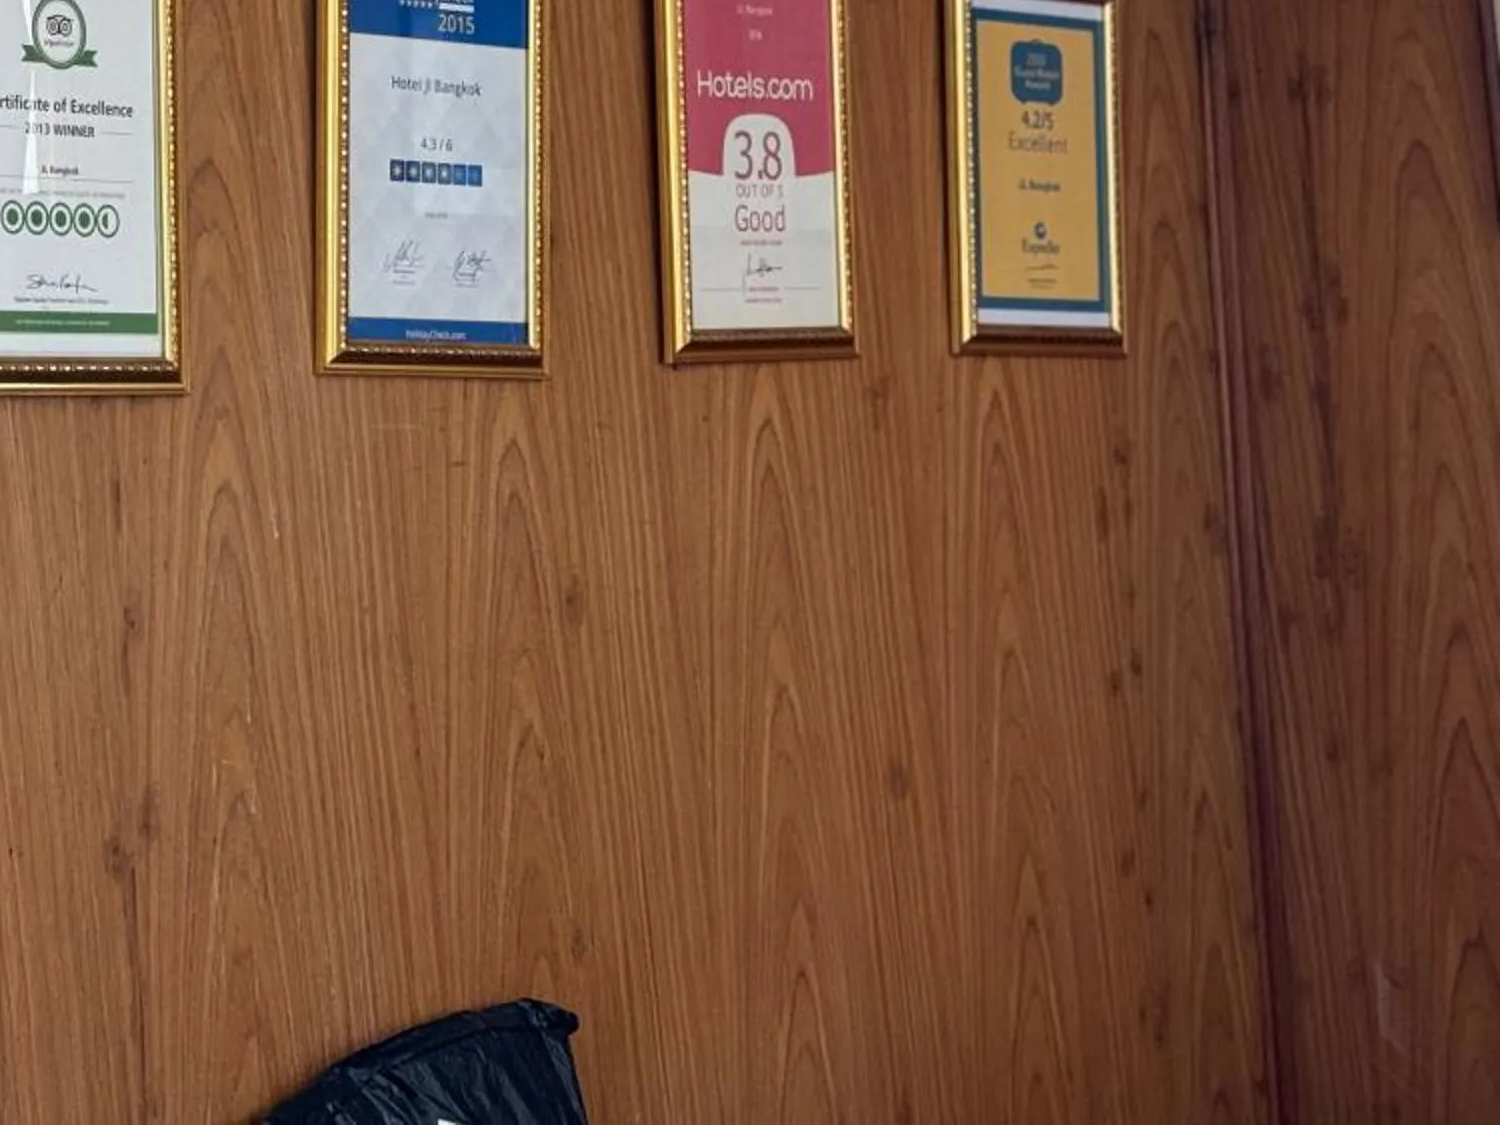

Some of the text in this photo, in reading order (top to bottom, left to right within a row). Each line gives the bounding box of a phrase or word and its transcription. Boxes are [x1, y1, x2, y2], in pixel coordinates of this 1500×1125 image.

[437, 14, 475, 35] 2015
[391, 75, 422, 91] Hotel
[434, 79, 482, 98] Bangkok
[696, 69, 814, 100] Hotels.com
[53, 97, 68, 114] of
[70, 98, 134, 118] Excellence
[53, 124, 96, 138] WINNER
[1008, 130, 1069, 155] Excellent
[733, 130, 783, 181] 3.8
[735, 184, 784, 198] OUT OF 5
[734, 204, 786, 233] Good
